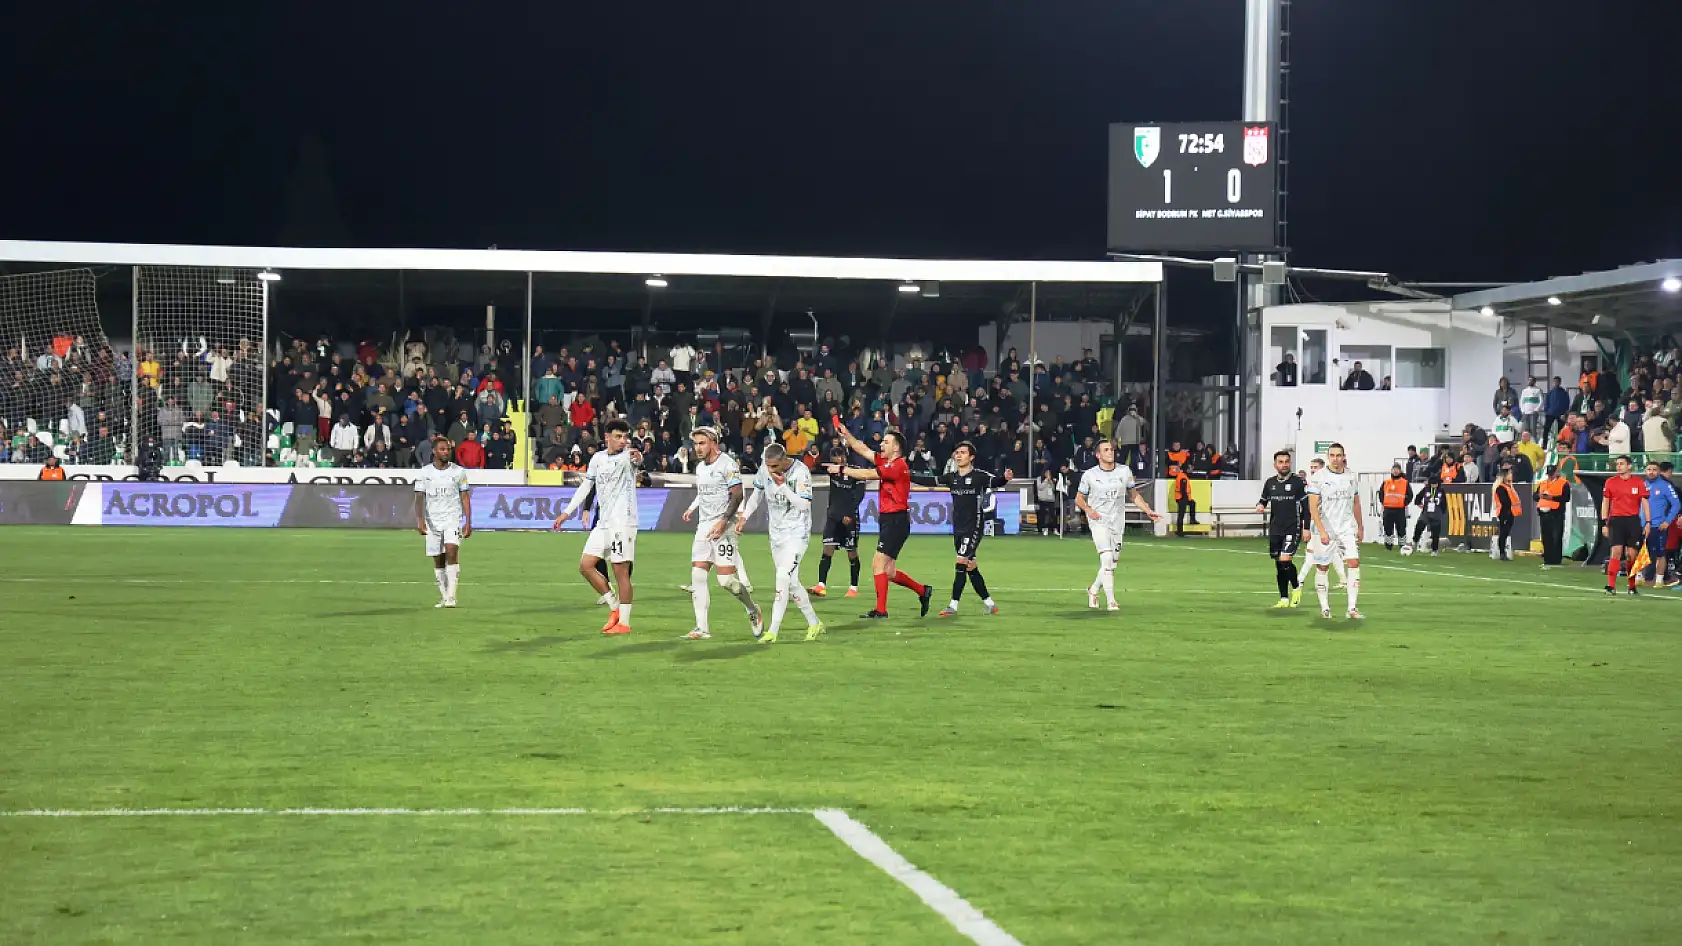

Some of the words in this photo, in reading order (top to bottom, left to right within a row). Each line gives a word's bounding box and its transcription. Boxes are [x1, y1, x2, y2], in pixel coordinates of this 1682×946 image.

[1178, 133, 1225, 154] 72:54
[1164, 169, 1171, 203] 1
[1227, 169, 1241, 203] 0
[102, 489, 260, 518] ACROPOL
[611, 541, 623, 554] 41
[717, 544, 734, 557] 99
[1284, 541, 1292, 551] 7
